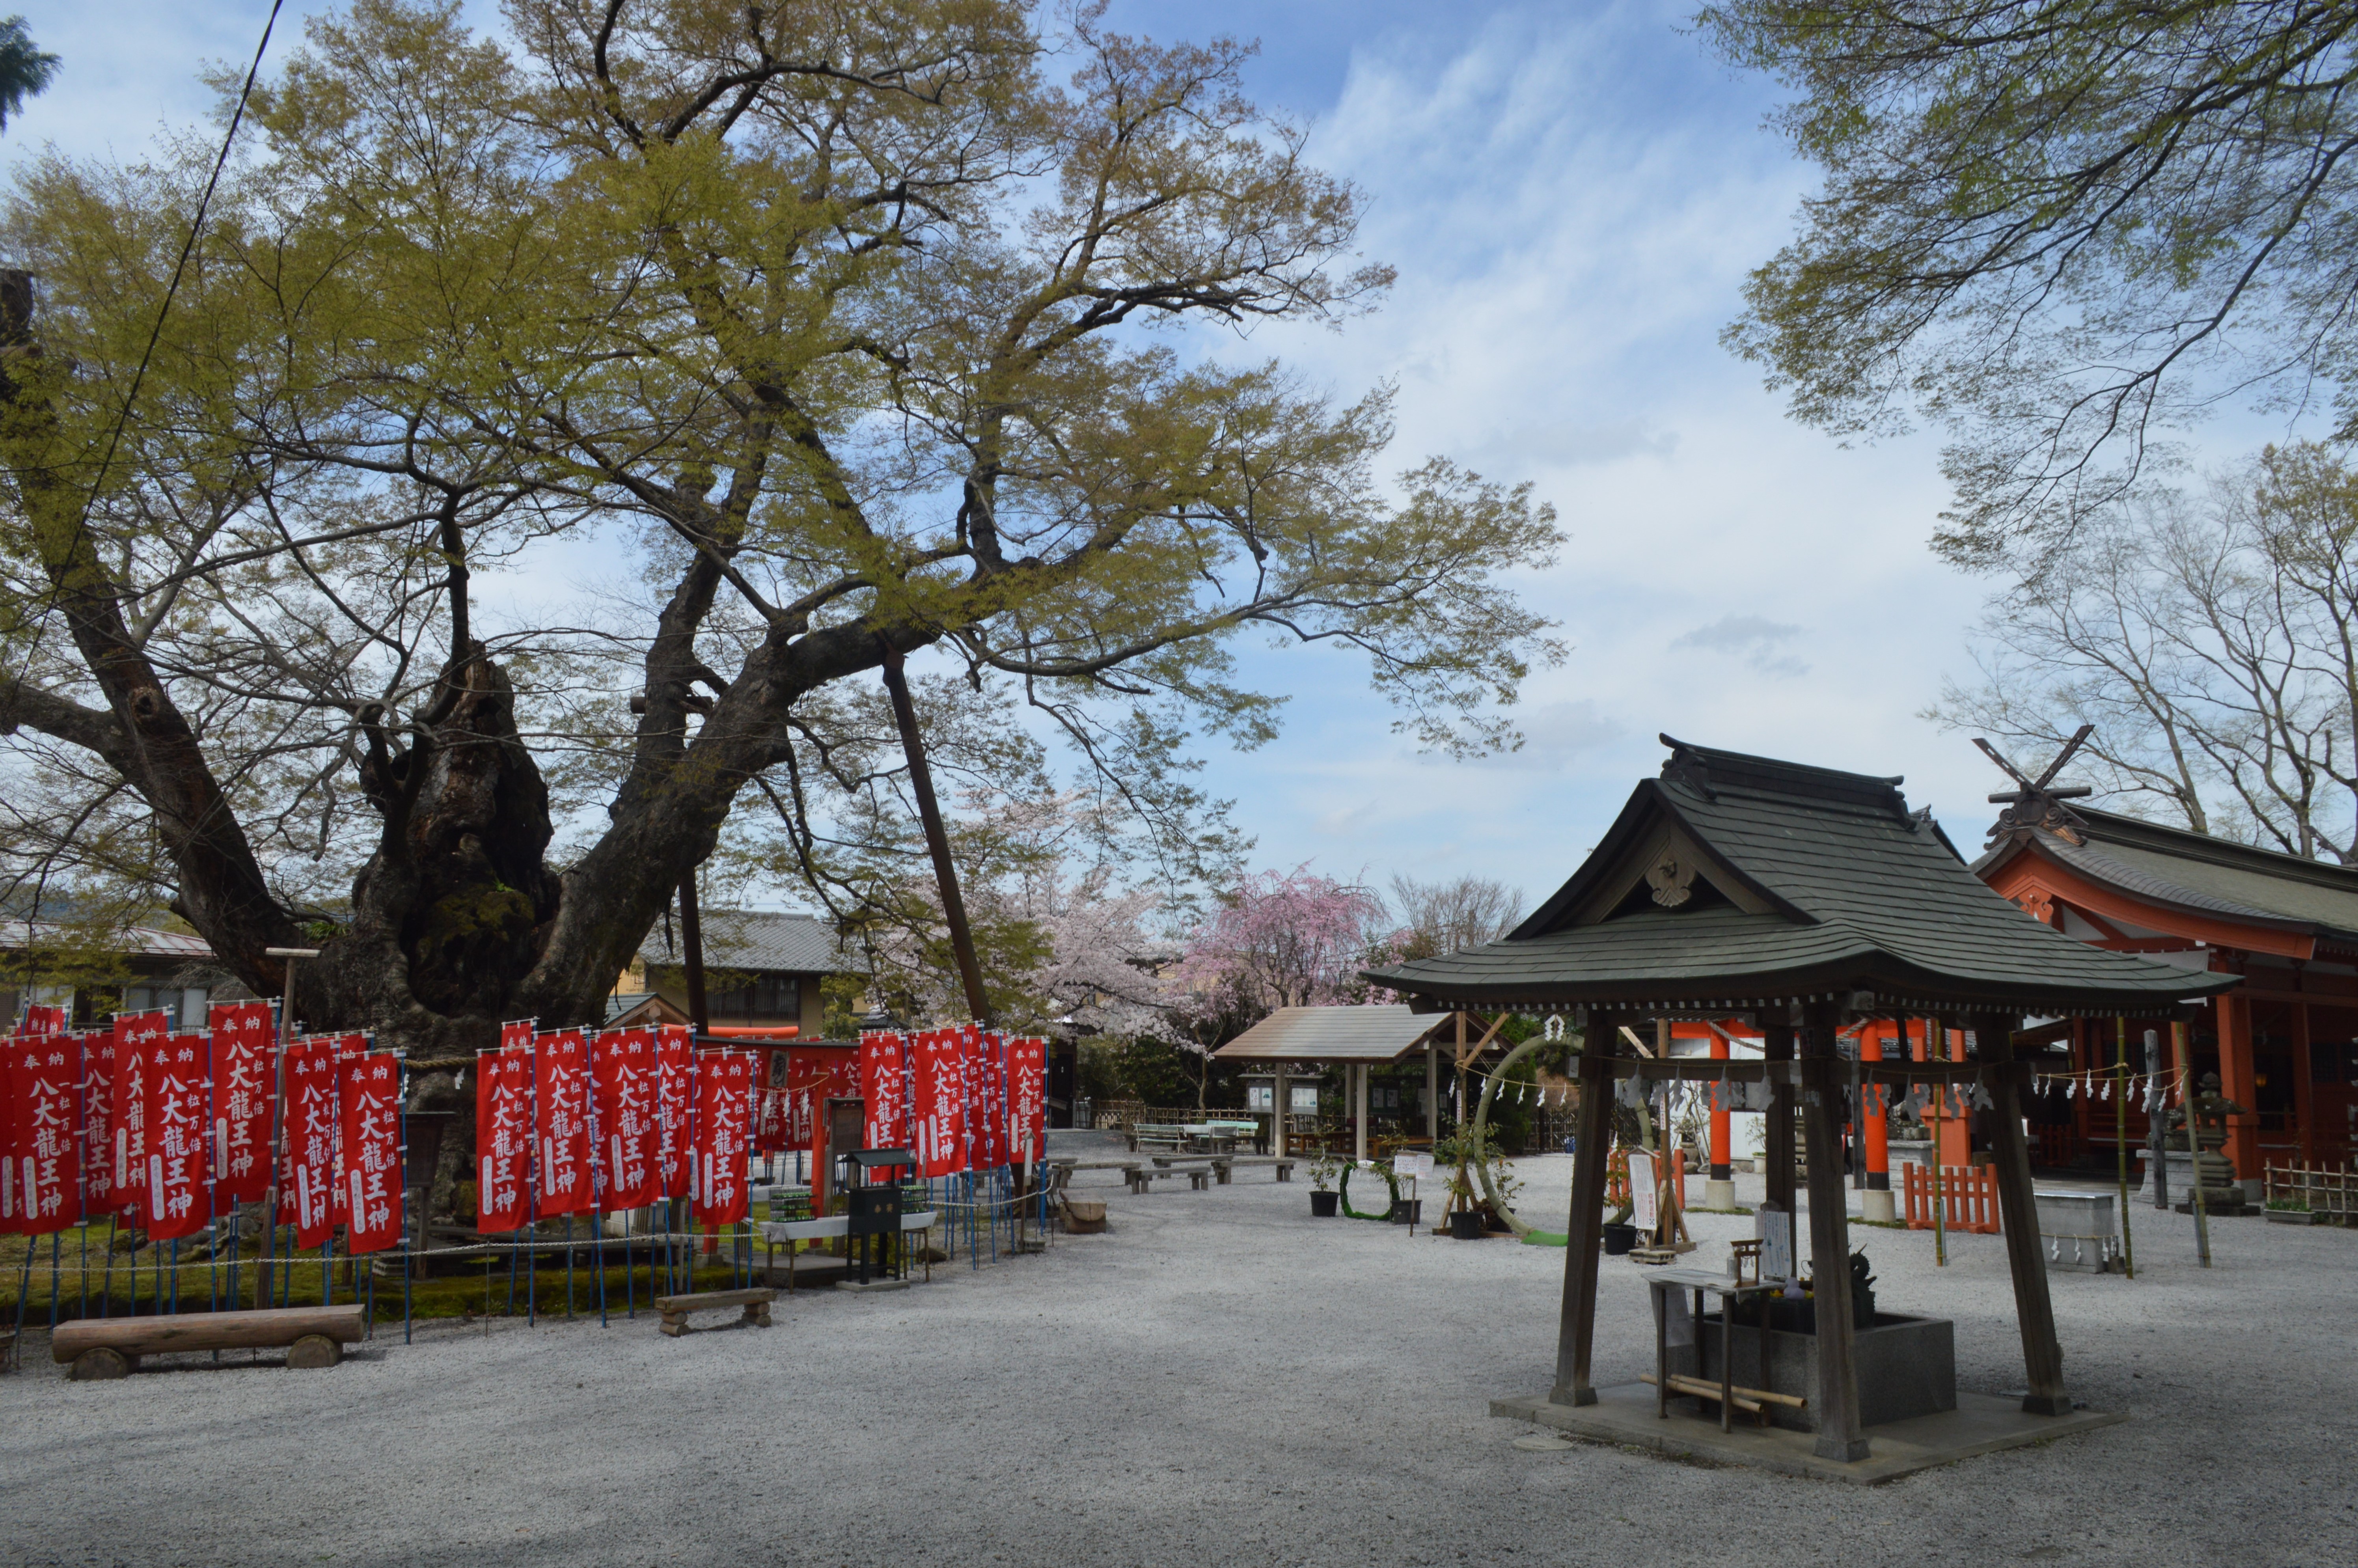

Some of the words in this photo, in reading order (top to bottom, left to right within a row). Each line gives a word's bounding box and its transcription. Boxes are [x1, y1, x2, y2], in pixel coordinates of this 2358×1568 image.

[80, 1046, 115, 1061] 奉納
[124, 1028, 156, 1044] 奉納
[222, 1016, 260, 1033] 奉納
[507, 1035, 527, 1048] 奉納
[546, 1040, 575, 1058] 奉納
[610, 1040, 641, 1057] 奉納
[652, 1038, 681, 1054] 奉納
[870, 1045, 895, 1059] 奉納
[927, 1040, 952, 1053] 奉納
[1016, 1049, 1038, 1060] 奉納
[24, 1052, 63, 1070] 奉納
[155, 1048, 194, 1066] 奉納
[253, 1046, 265, 1115] 一粒万倍
[295, 1058, 326, 1076] 奉納
[350, 1066, 388, 1083] 奉納
[489, 1060, 520, 1077] 奉納
[710, 1064, 741, 1079] 奉納
[949, 1061, 960, 1114] 一粒万倍
[969, 1055, 980, 1107] 一粒万倍
[986, 1062, 997, 1111] 一粒万倍
[58, 1082, 71, 1153] 一粒万倍
[187, 1079, 201, 1153] 一粒万倍
[225, 1040, 254, 1178] 八大龍王神
[514, 1087, 525, 1153] 一粒万倍
[570, 1068, 583, 1134] 一粒万倍
[637, 1068, 651, 1133] 一粒万倍
[655, 1060, 678, 1181] 八大龍王神
[675, 1065, 686, 1126] 一粒万倍
[734, 1091, 744, 1152] 一粒万倍
[873, 1064, 895, 1148] 八大龍王
[891, 1067, 900, 1120] 一粒万倍
[931, 1057, 954, 1160] 八大龍王神
[29, 1077, 62, 1217] 八大龍王神
[84, 1068, 111, 1199] 八大龍王神
[158, 1073, 193, 1218] 八大龍王神
[300, 1083, 327, 1227] 八大龍王神
[382, 1096, 396, 1167] 一粒万倍
[490, 1083, 516, 1213] 八大龍王神
[549, 1064, 576, 1193] 八大龍王神
[615, 1063, 645, 1190] 八大龍王神
[712, 1085, 735, 1207] 八大龍王神
[356, 1090, 390, 1231] 八大龍王神
